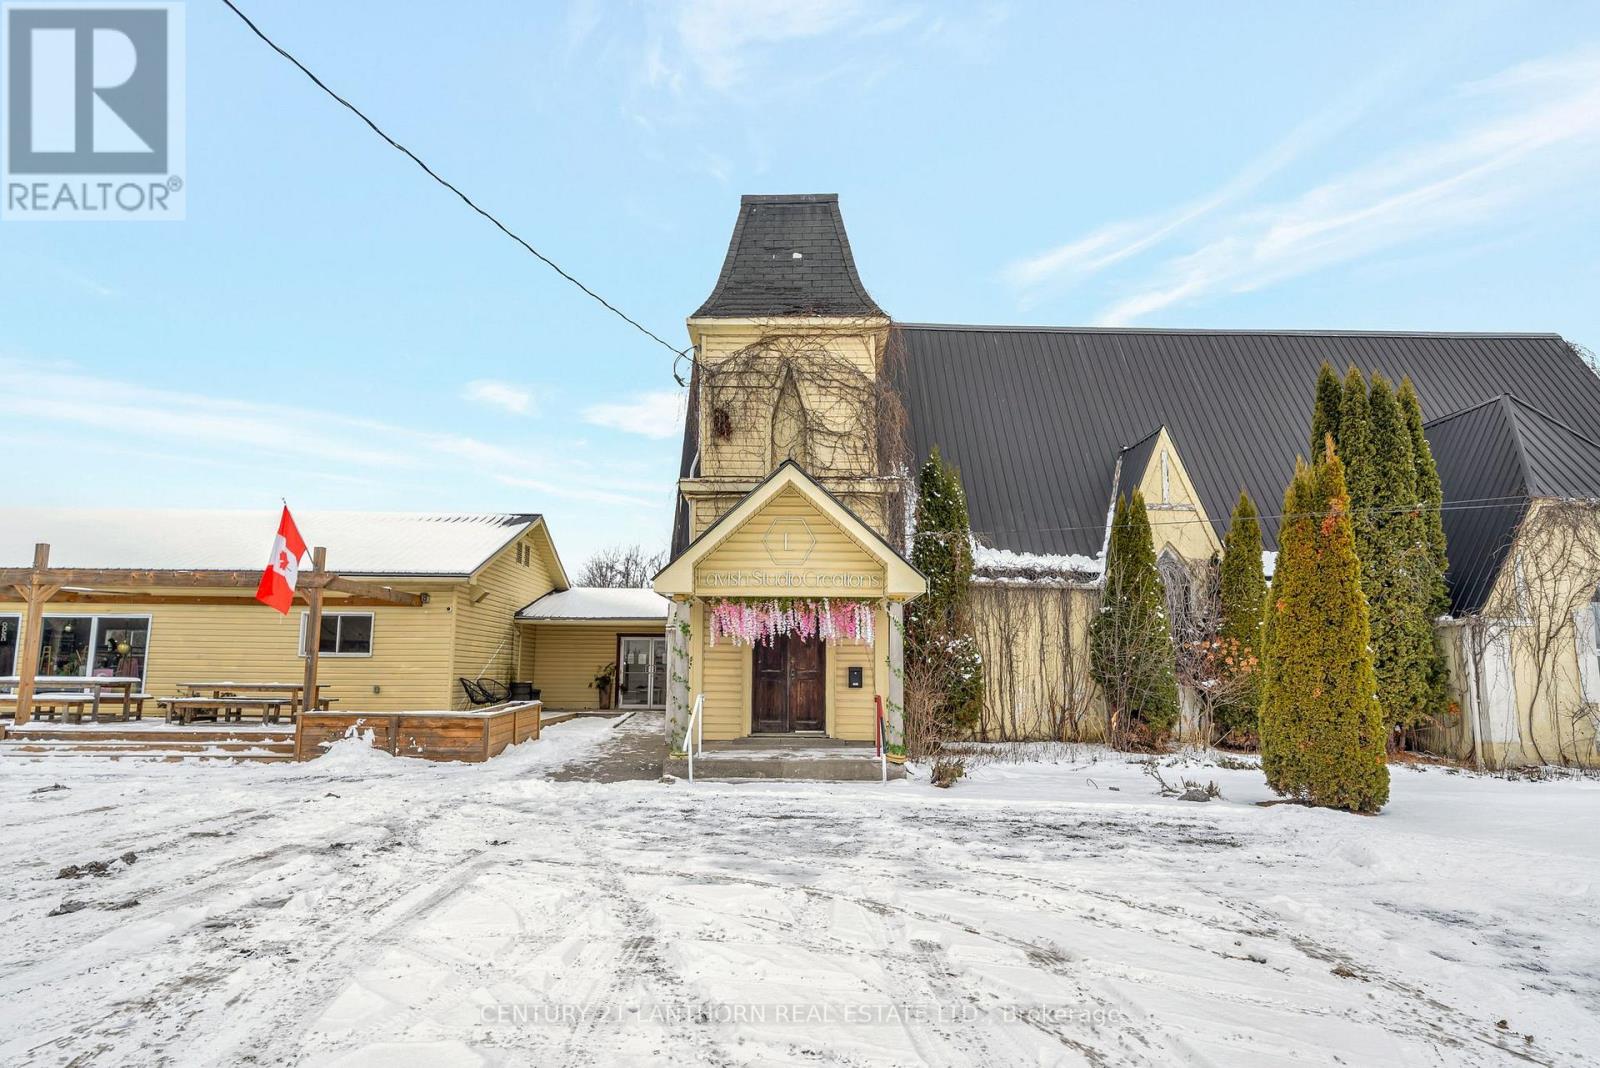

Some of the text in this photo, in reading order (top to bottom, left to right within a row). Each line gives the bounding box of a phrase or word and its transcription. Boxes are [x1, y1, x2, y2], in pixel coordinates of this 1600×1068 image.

[783, 531, 794, 552] L
[752, 567, 802, 588] Studio
[803, 568, 880, 588] Creations
